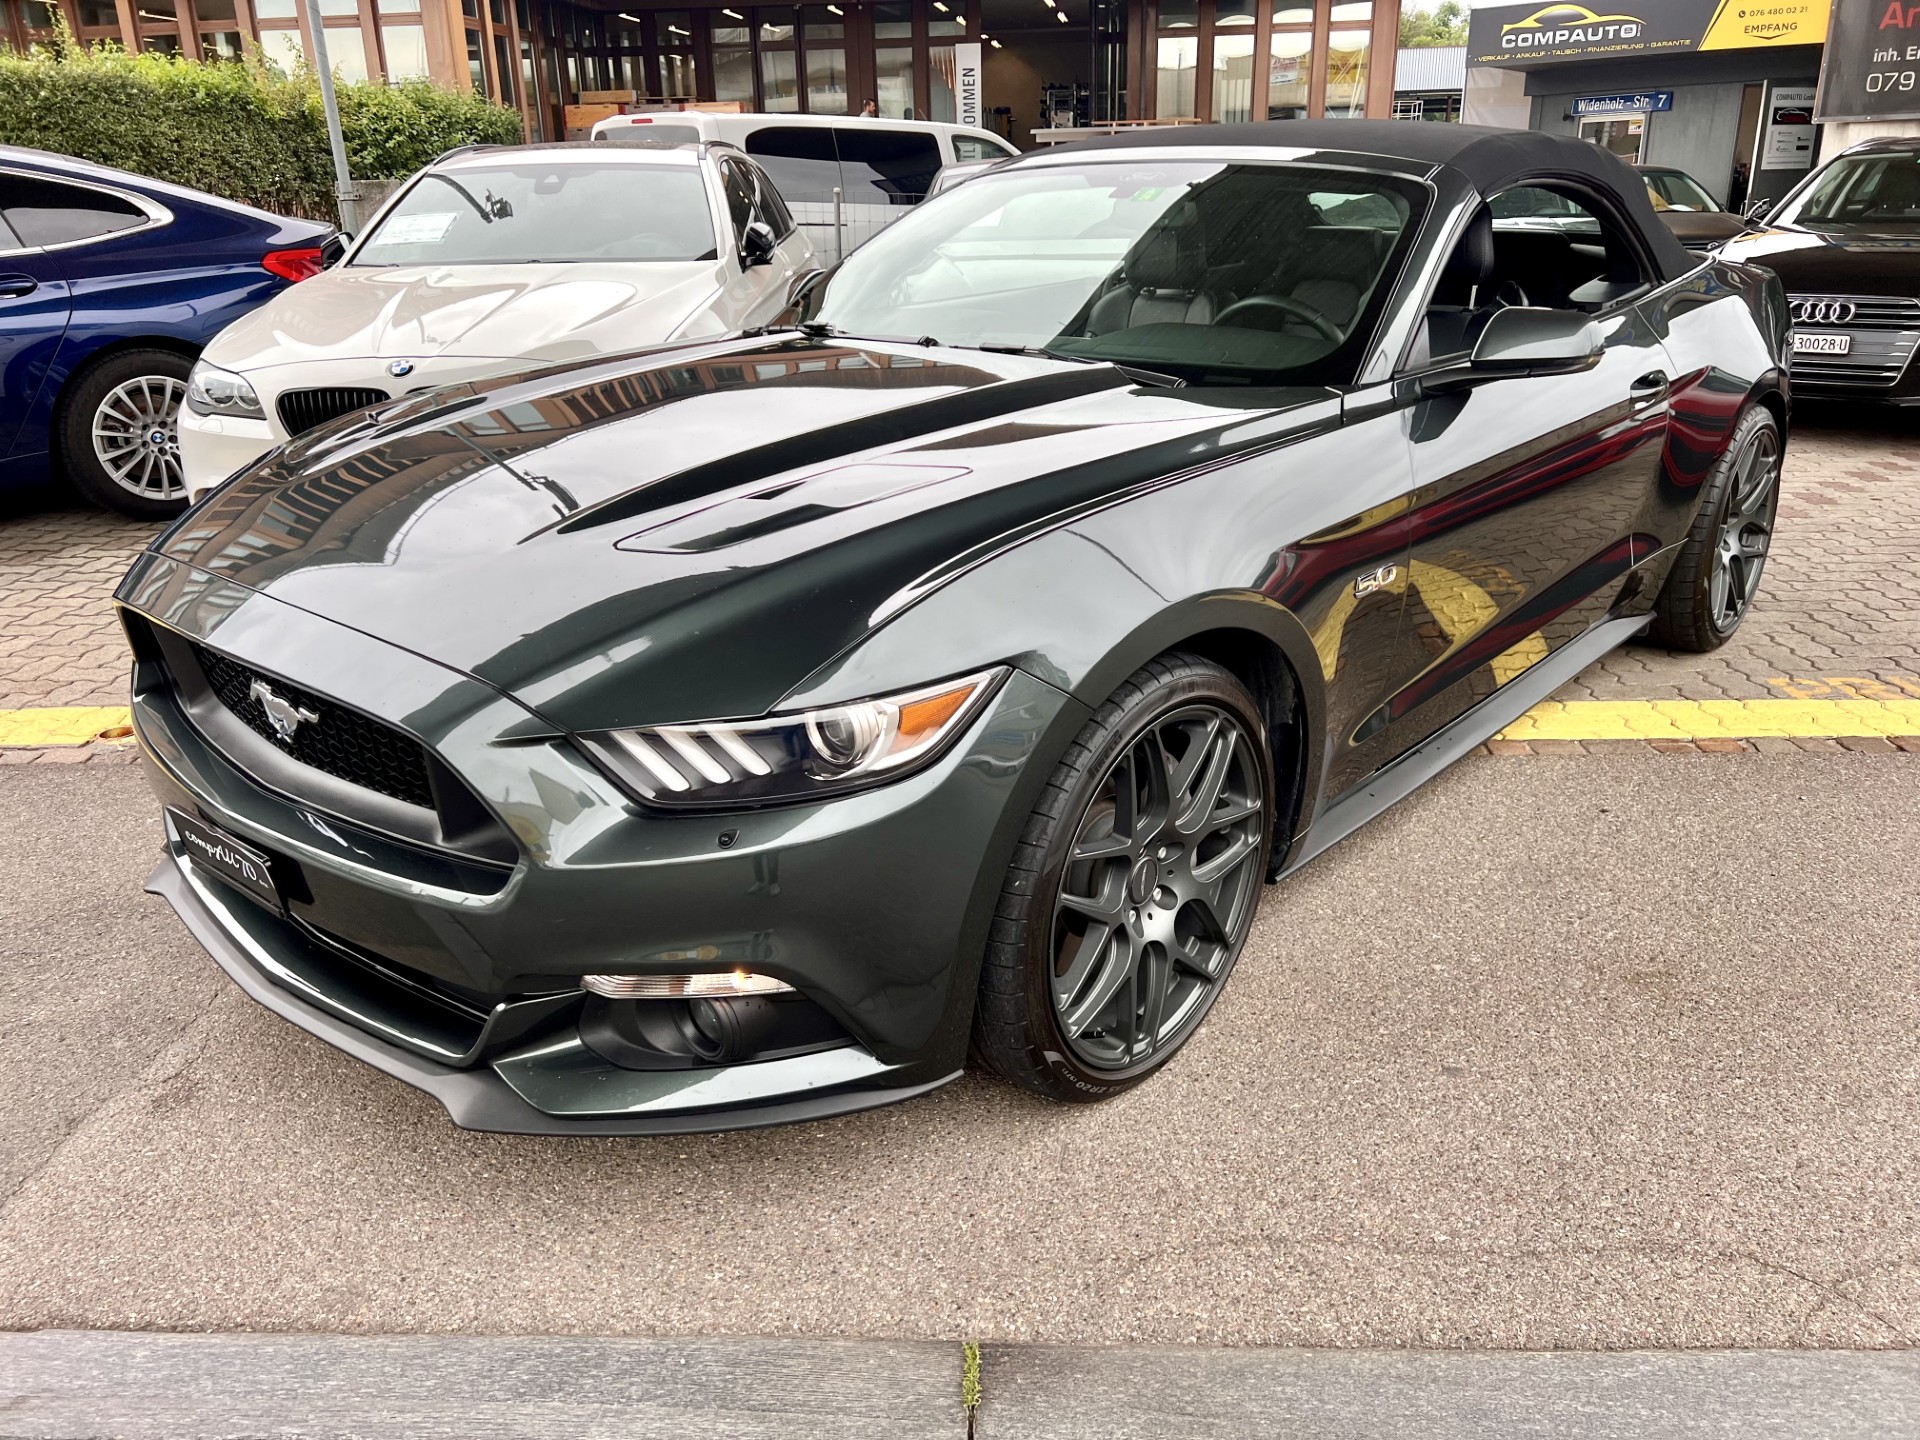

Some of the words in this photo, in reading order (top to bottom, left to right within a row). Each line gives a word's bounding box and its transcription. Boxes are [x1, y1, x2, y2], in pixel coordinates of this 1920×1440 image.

[1749, 9, 1765, 17] 076
[1767, 7, 1784, 15] 480
[1786, 6, 1797, 14] 02
[1799, 5, 1808, 13] 21
[1501, 23, 1638, 48] COMPAUTO
[1743, 22, 1798, 34] EMPFANG
[1478, 53, 1511, 62] VERKAUF
[1515, 50, 1546, 59] ANKAUF
[1551, 47, 1582, 56] TAUSCH
[1587, 42, 1644, 53] FINANZIERUNG
[1650, 39, 1691, 48] GARANTIE
[1872, 47, 1901, 62] inh.
[1865, 71, 1916, 92] 079
[1578, 97, 1625, 111] Widenholz
[1657, 94, 1668, 108] 7
[1776, 93, 1803, 101] COMPAUTO
[1803, 93, 1815, 101] Gmb
[1354, 563, 1397, 599] 5.0
[1075, 1081, 1108, 1094] ZR20
